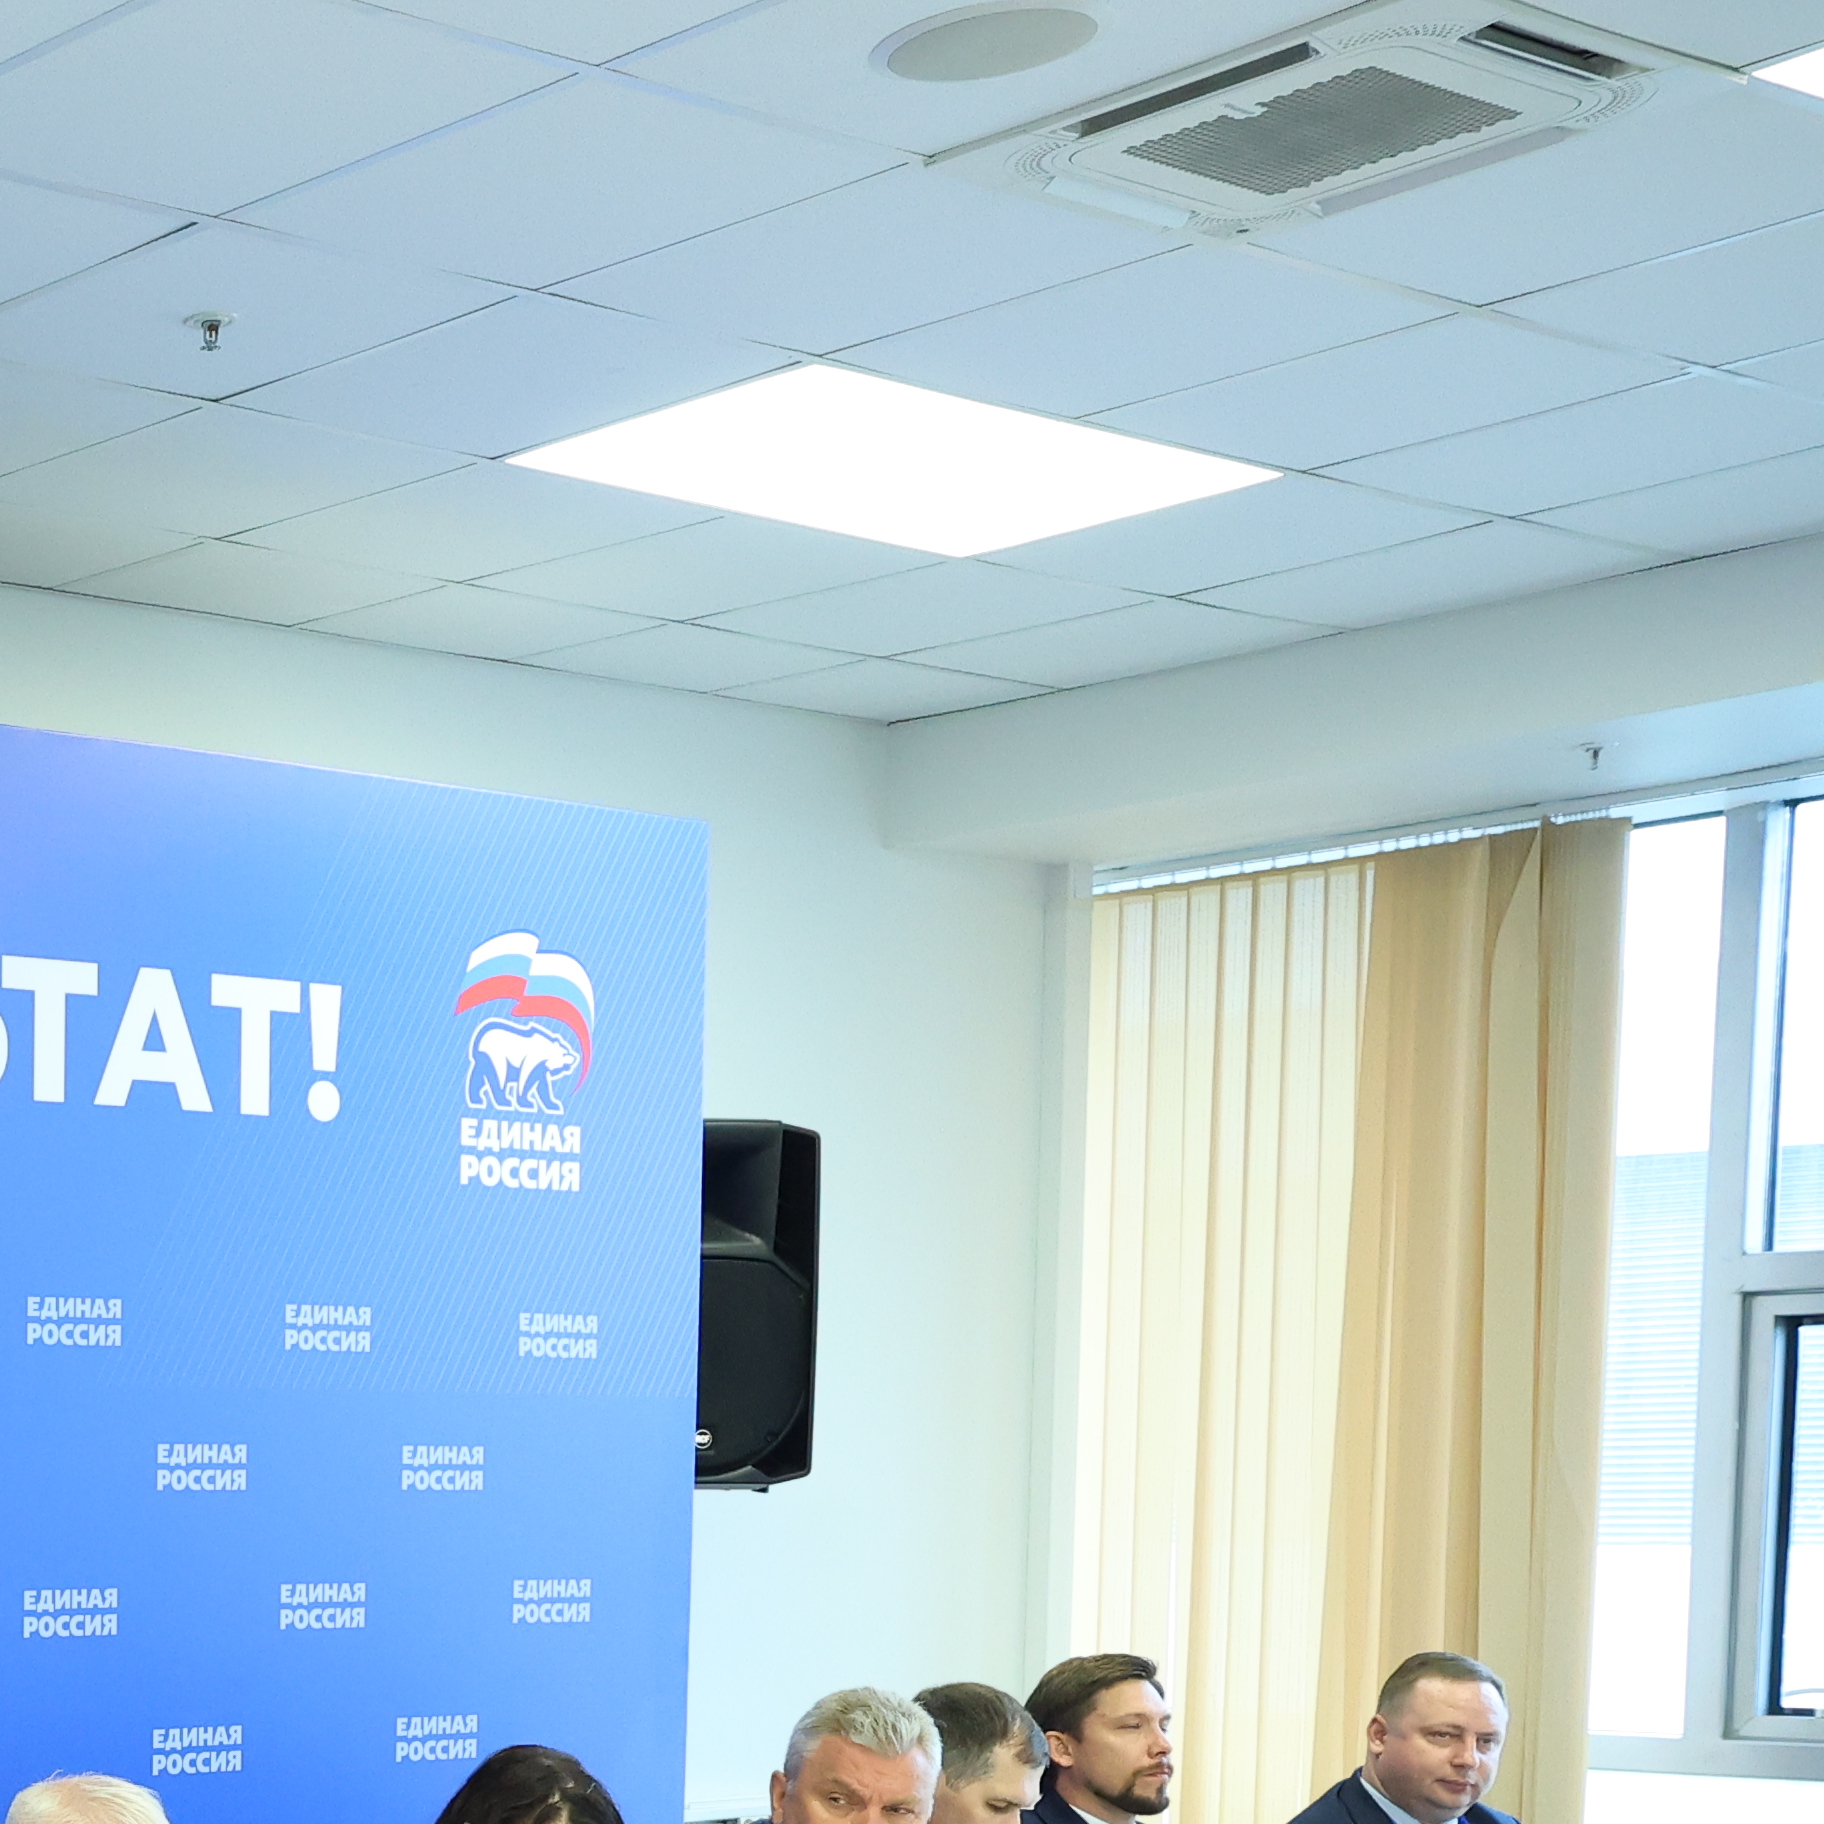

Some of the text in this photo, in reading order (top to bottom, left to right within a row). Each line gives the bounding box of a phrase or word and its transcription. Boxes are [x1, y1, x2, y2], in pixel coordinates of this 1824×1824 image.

[460, 1117, 581, 1154] ЕДИНАЯ
[460, 1154, 580, 1192] РОССИЯ
[27, 1297, 122, 1320] ЕДИНАЯ
[285, 1304, 372, 1327] ЕДИНАЯ
[27, 1323, 121, 1346] РОССИЯ
[520, 1313, 598, 1334] ЕДИНАЯ
[285, 1329, 370, 1352] РОССИЯ
[519, 1336, 597, 1358] РОССИЯ
[157, 1444, 247, 1466] ЕДИНАЯ
[402, 1446, 484, 1467] ЕДИНАЯ
[157, 1469, 246, 1490] РОССИЯ
[402, 1470, 483, 1490] РОССИЯ
[24, 1588, 117, 1613] ЕДИНАЯ
[281, 1583, 365, 1606] ЕДИНАЯ
[513, 1579, 591, 1601] ЕДИНАЯ
[280, 1607, 365, 1630] РОССИЯ
[512, 1603, 590, 1623] РОССИЯ
[23, 1614, 117, 1638] РОССИЯ
[153, 1725, 242, 1751] ЕДИНАЯ
[396, 1715, 477, 1738] ЕДИНАЯ
[396, 1739, 477, 1762] РОССИЯ
[152, 1750, 242, 1776] РОССИЯ
